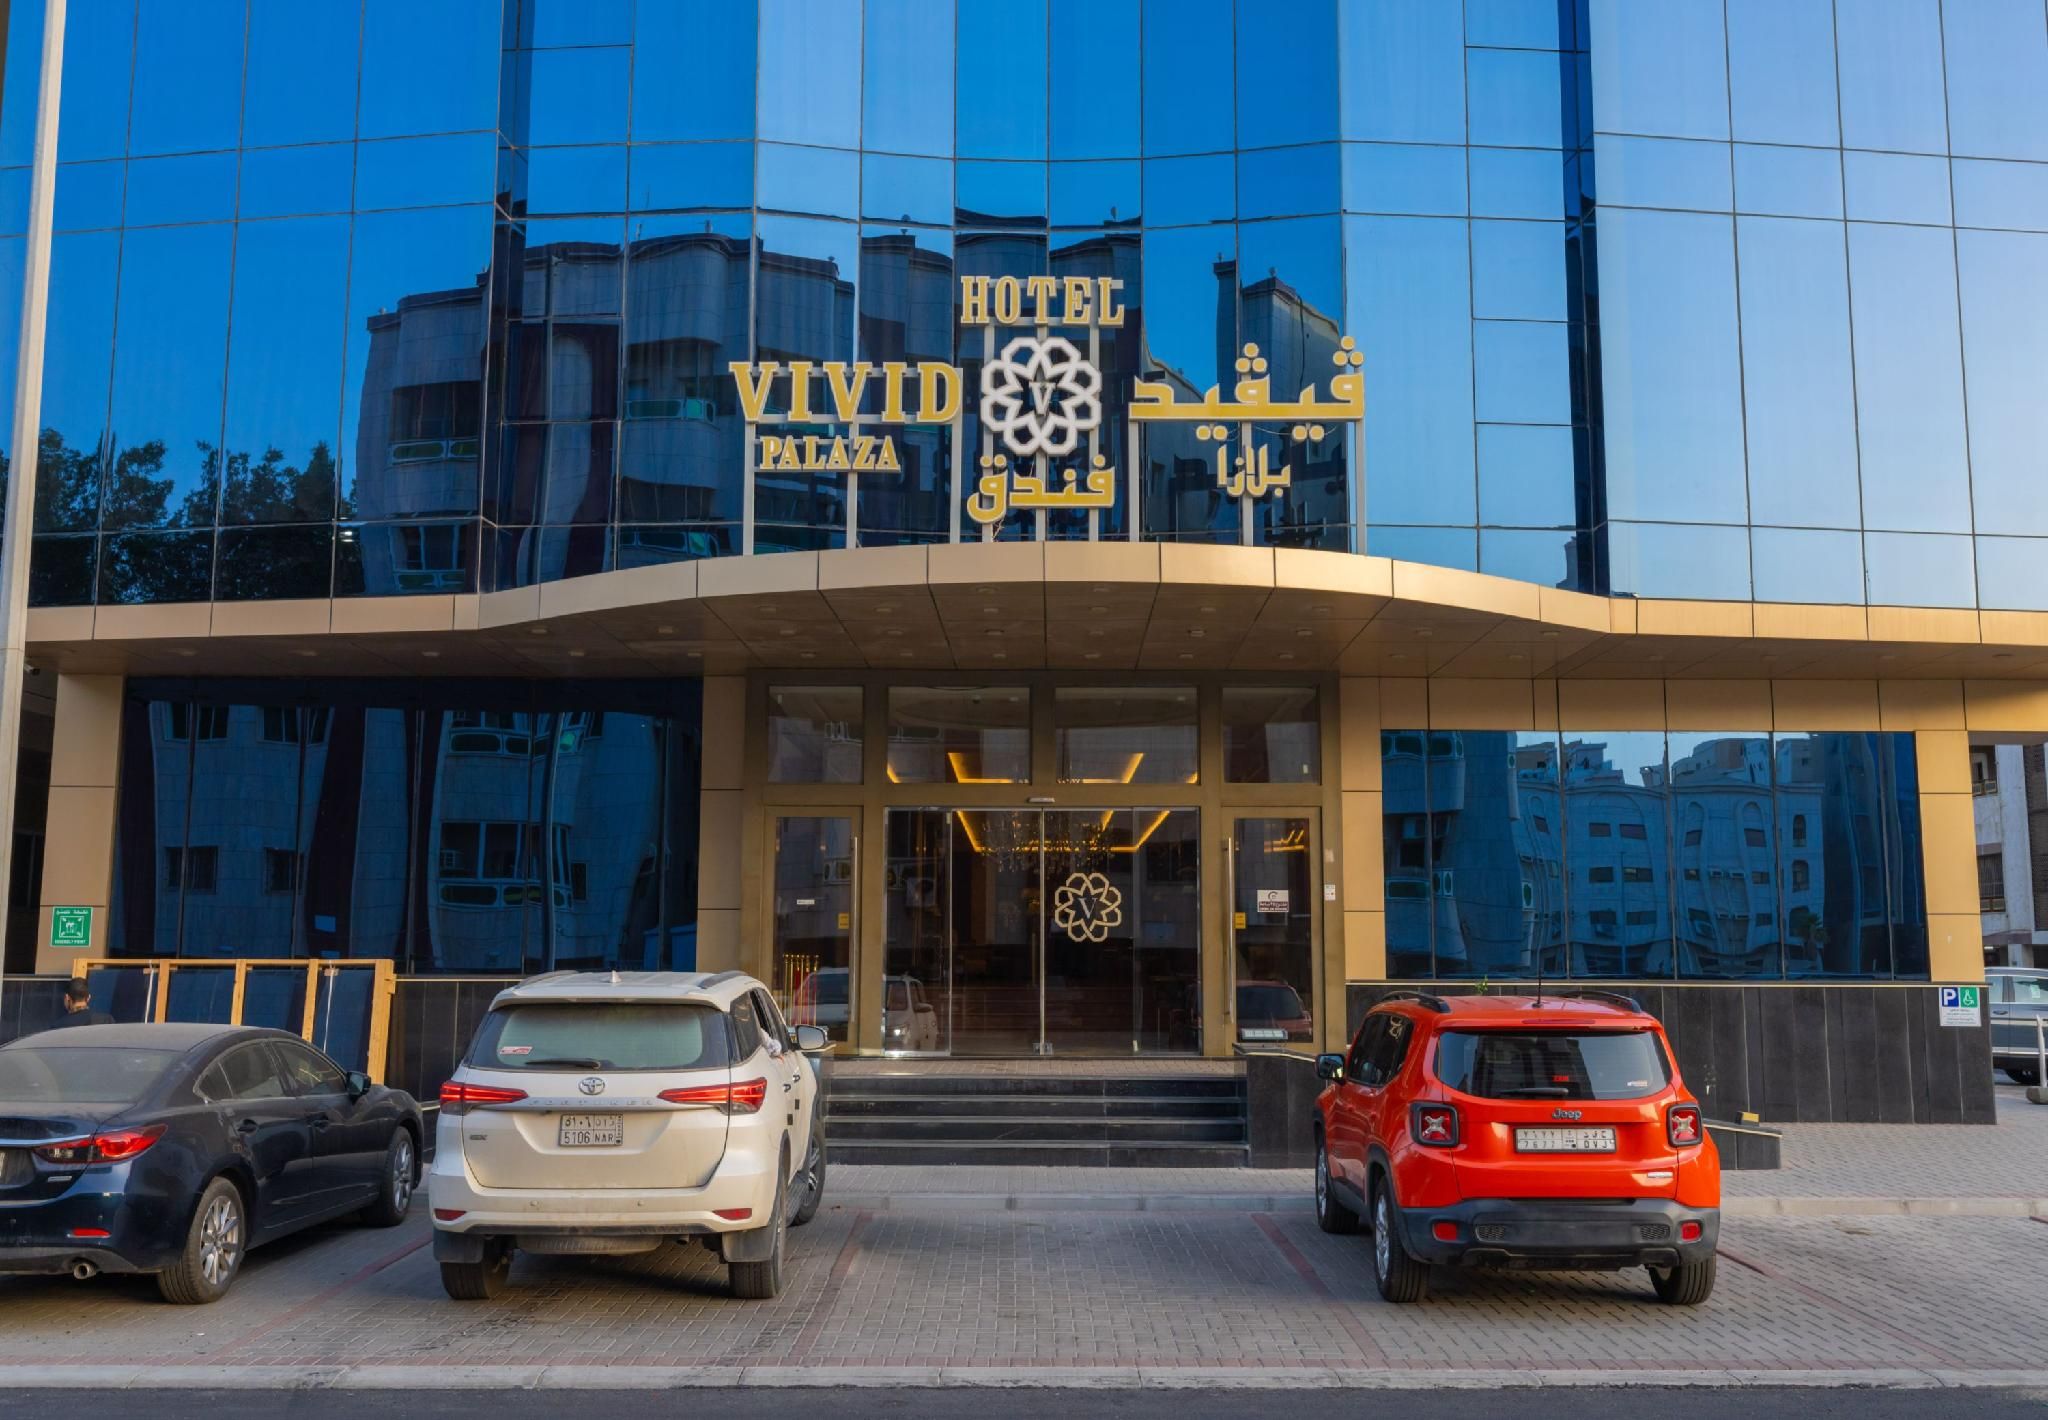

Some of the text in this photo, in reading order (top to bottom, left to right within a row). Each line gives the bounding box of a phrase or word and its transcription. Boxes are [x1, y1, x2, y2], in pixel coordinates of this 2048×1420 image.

[961, 275, 1124, 326] HOTEL
[728, 361, 962, 423] VIVID
[1029, 382, 1056, 415] V
[759, 435, 901, 470] PALAZA
[1217, 443, 1291, 498] بلازا
[967, 454, 1116, 524] فندق
[1078, 897, 1098, 919] V
[1943, 988, 1957, 1006] P
[1552, 1107, 1582, 1120] Jeep
[564, 1131, 614, 1144] 5106 NAR
